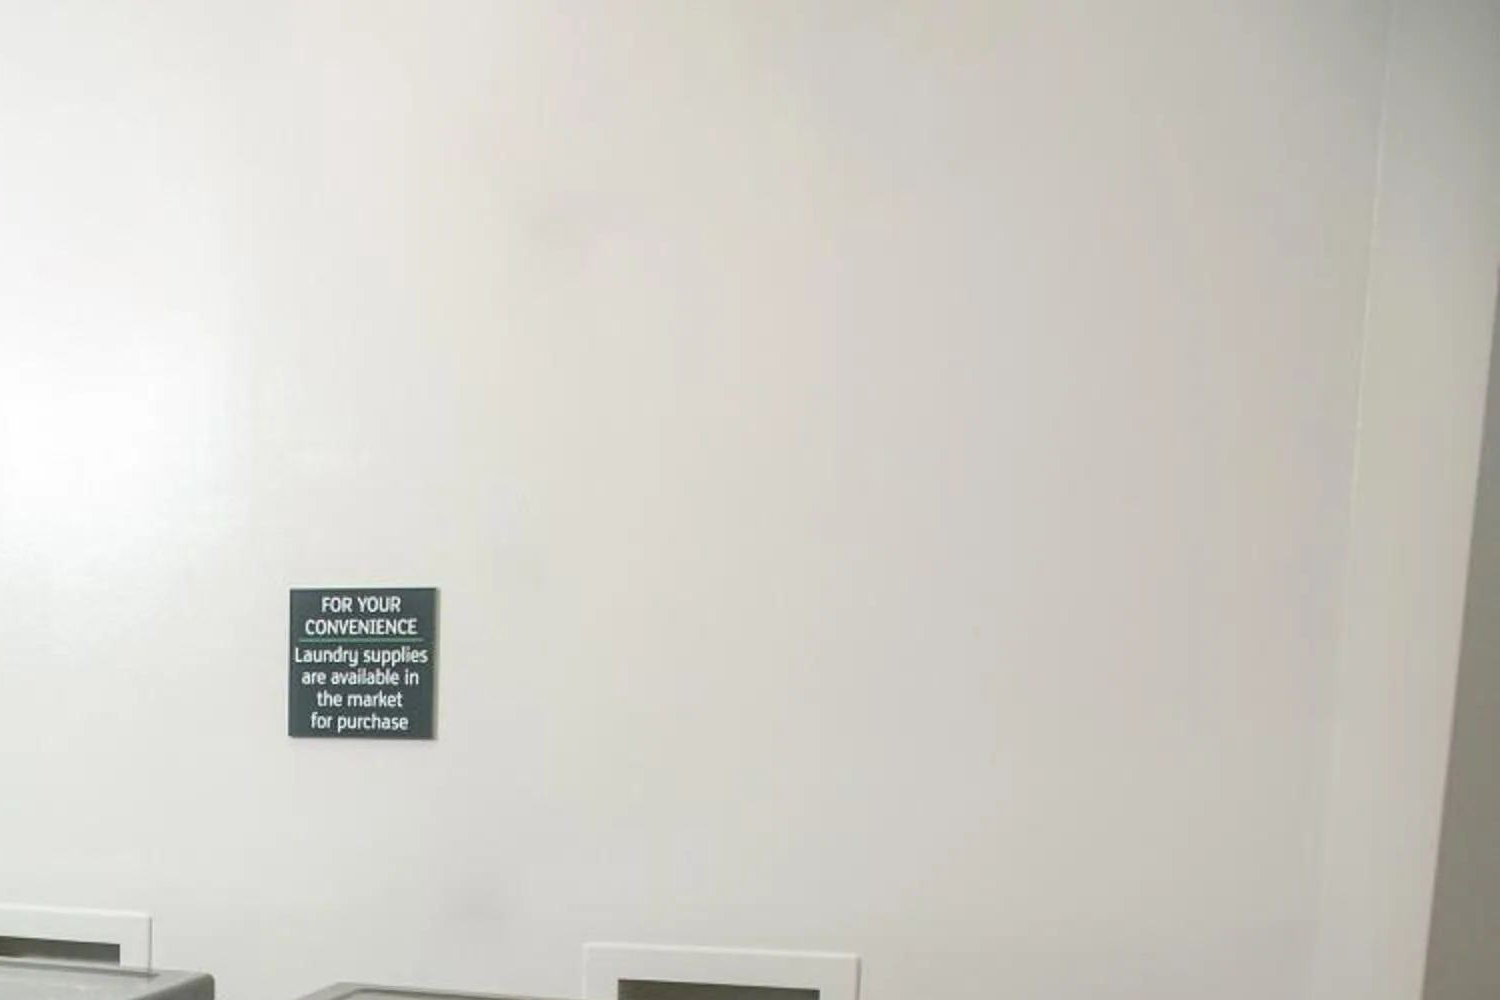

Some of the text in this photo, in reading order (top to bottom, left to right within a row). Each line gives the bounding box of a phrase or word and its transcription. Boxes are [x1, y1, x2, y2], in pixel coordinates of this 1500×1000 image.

[321, 596, 401, 613] FOR YOUR
[305, 618, 418, 635] CONVENIENCE
[294, 646, 429, 667] Laundry supplies
[301, 668, 419, 685] are available in
[316, 691, 403, 707] the market
[310, 712, 409, 733] for purchase
